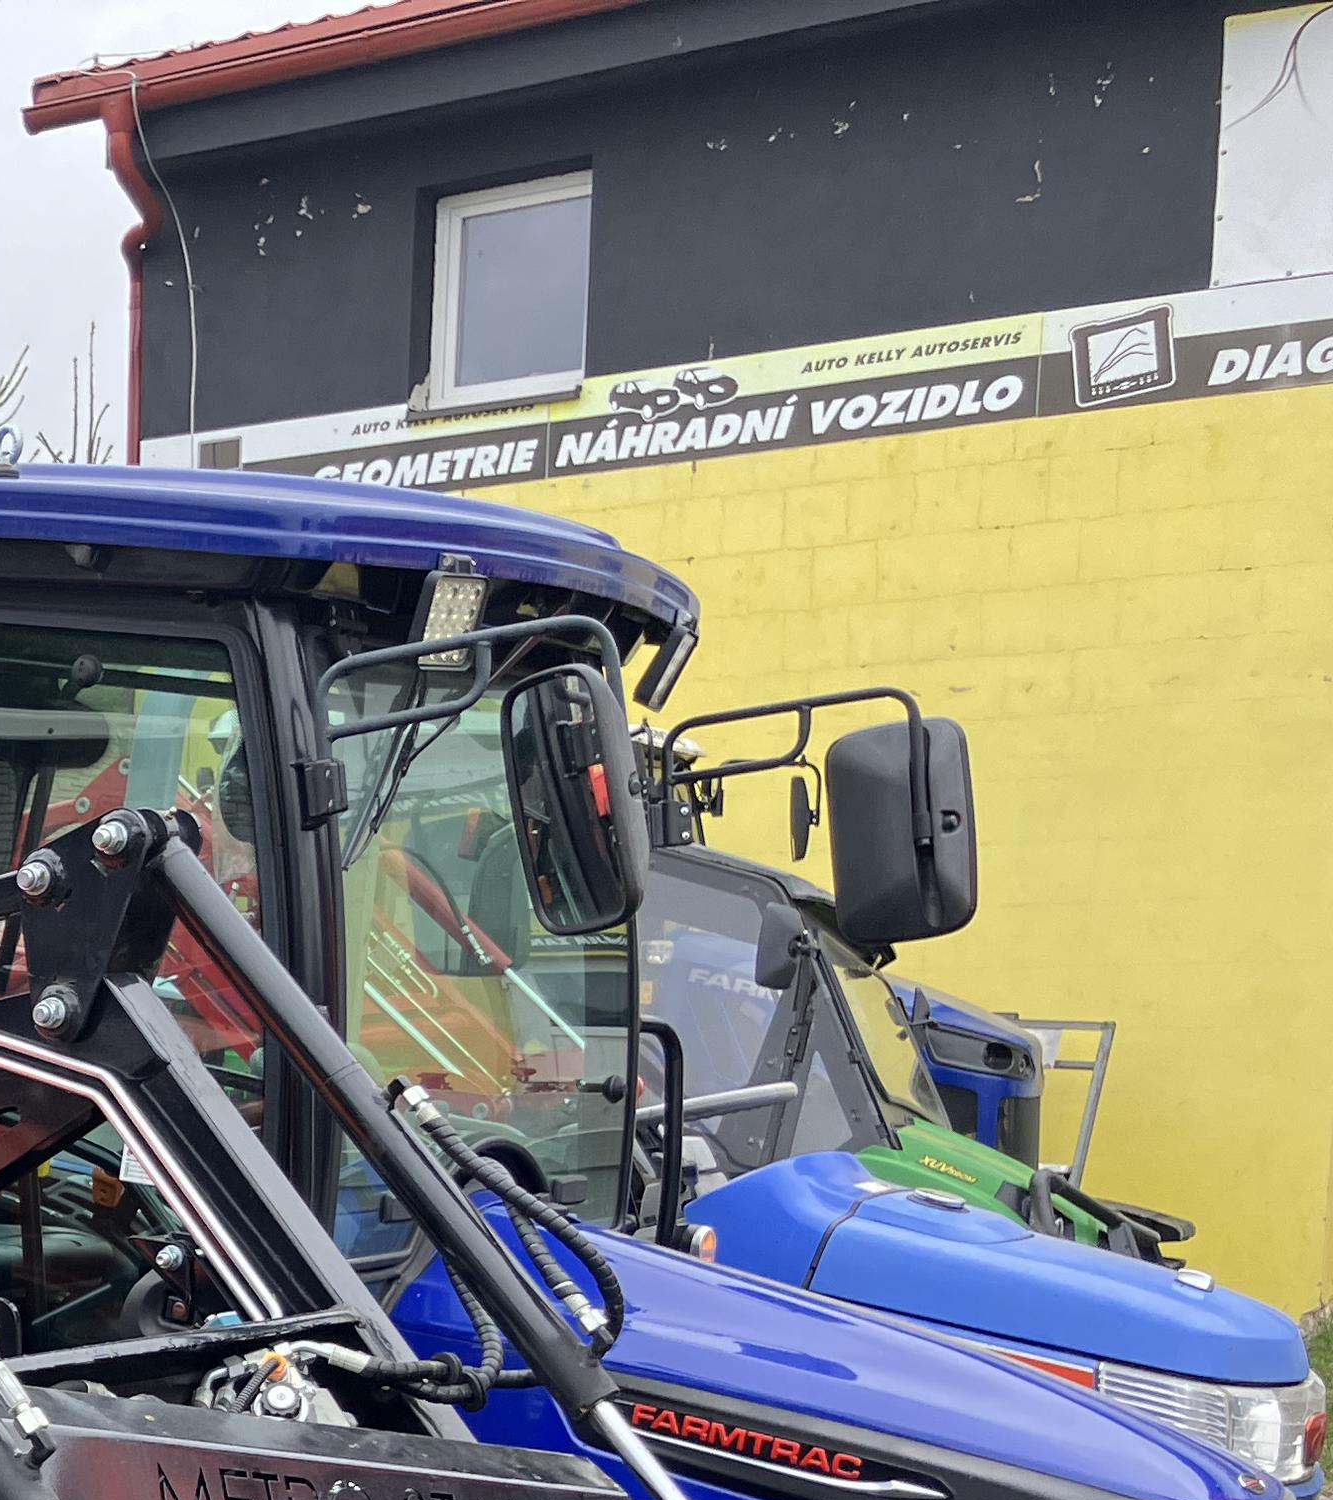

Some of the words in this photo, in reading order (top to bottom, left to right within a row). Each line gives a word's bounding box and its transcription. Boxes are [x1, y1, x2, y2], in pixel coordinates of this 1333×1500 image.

[801, 356, 849, 374] AUTO
[854, 346, 907, 367] KELLY
[910, 331, 1023, 359] AUTOSERVIS
[351, 420, 391, 436] AUTO
[554, 394, 800, 468] NÁHRADNÍ
[810, 375, 1026, 436] VOZIDLO
[632, 1403, 863, 1480] FARMTRAC
